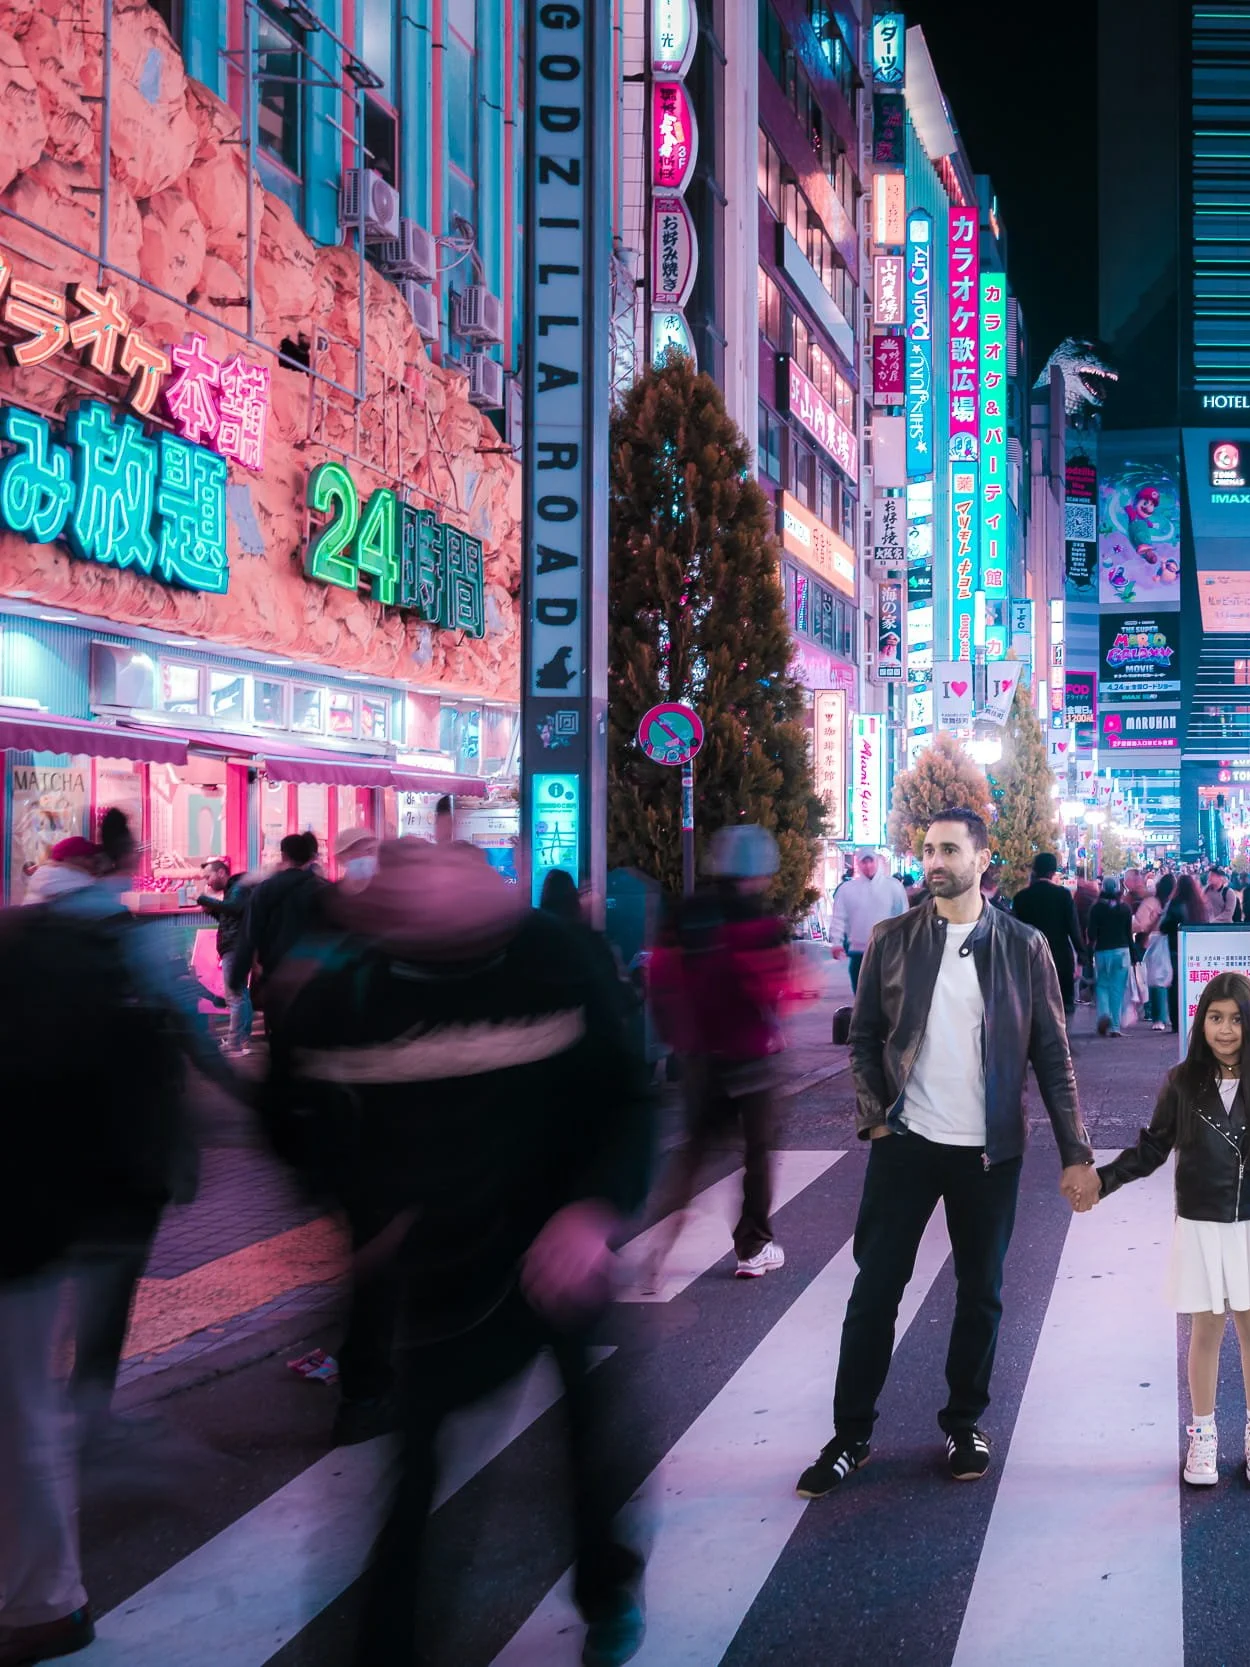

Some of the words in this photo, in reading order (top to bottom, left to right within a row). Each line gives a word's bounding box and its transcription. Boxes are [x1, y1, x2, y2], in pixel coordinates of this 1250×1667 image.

[537, 3, 581, 393] GODZILLA
[0, 256, 173, 415] ラオケ
[951, 215, 976, 423] カラオケ歌広場
[909, 355, 926, 439] SHINJUKU
[1203, 395, 1250, 409] HOTEL
[537, 441, 580, 626] ROAD
[957, 500, 974, 600] マツモトキヨシ
[881, 586, 898, 630] 海の家
[1125, 664, 1155, 673] MOVIE
[1126, 716, 1177, 730] MARUHAN
[14, 771, 85, 793] MATCHA
